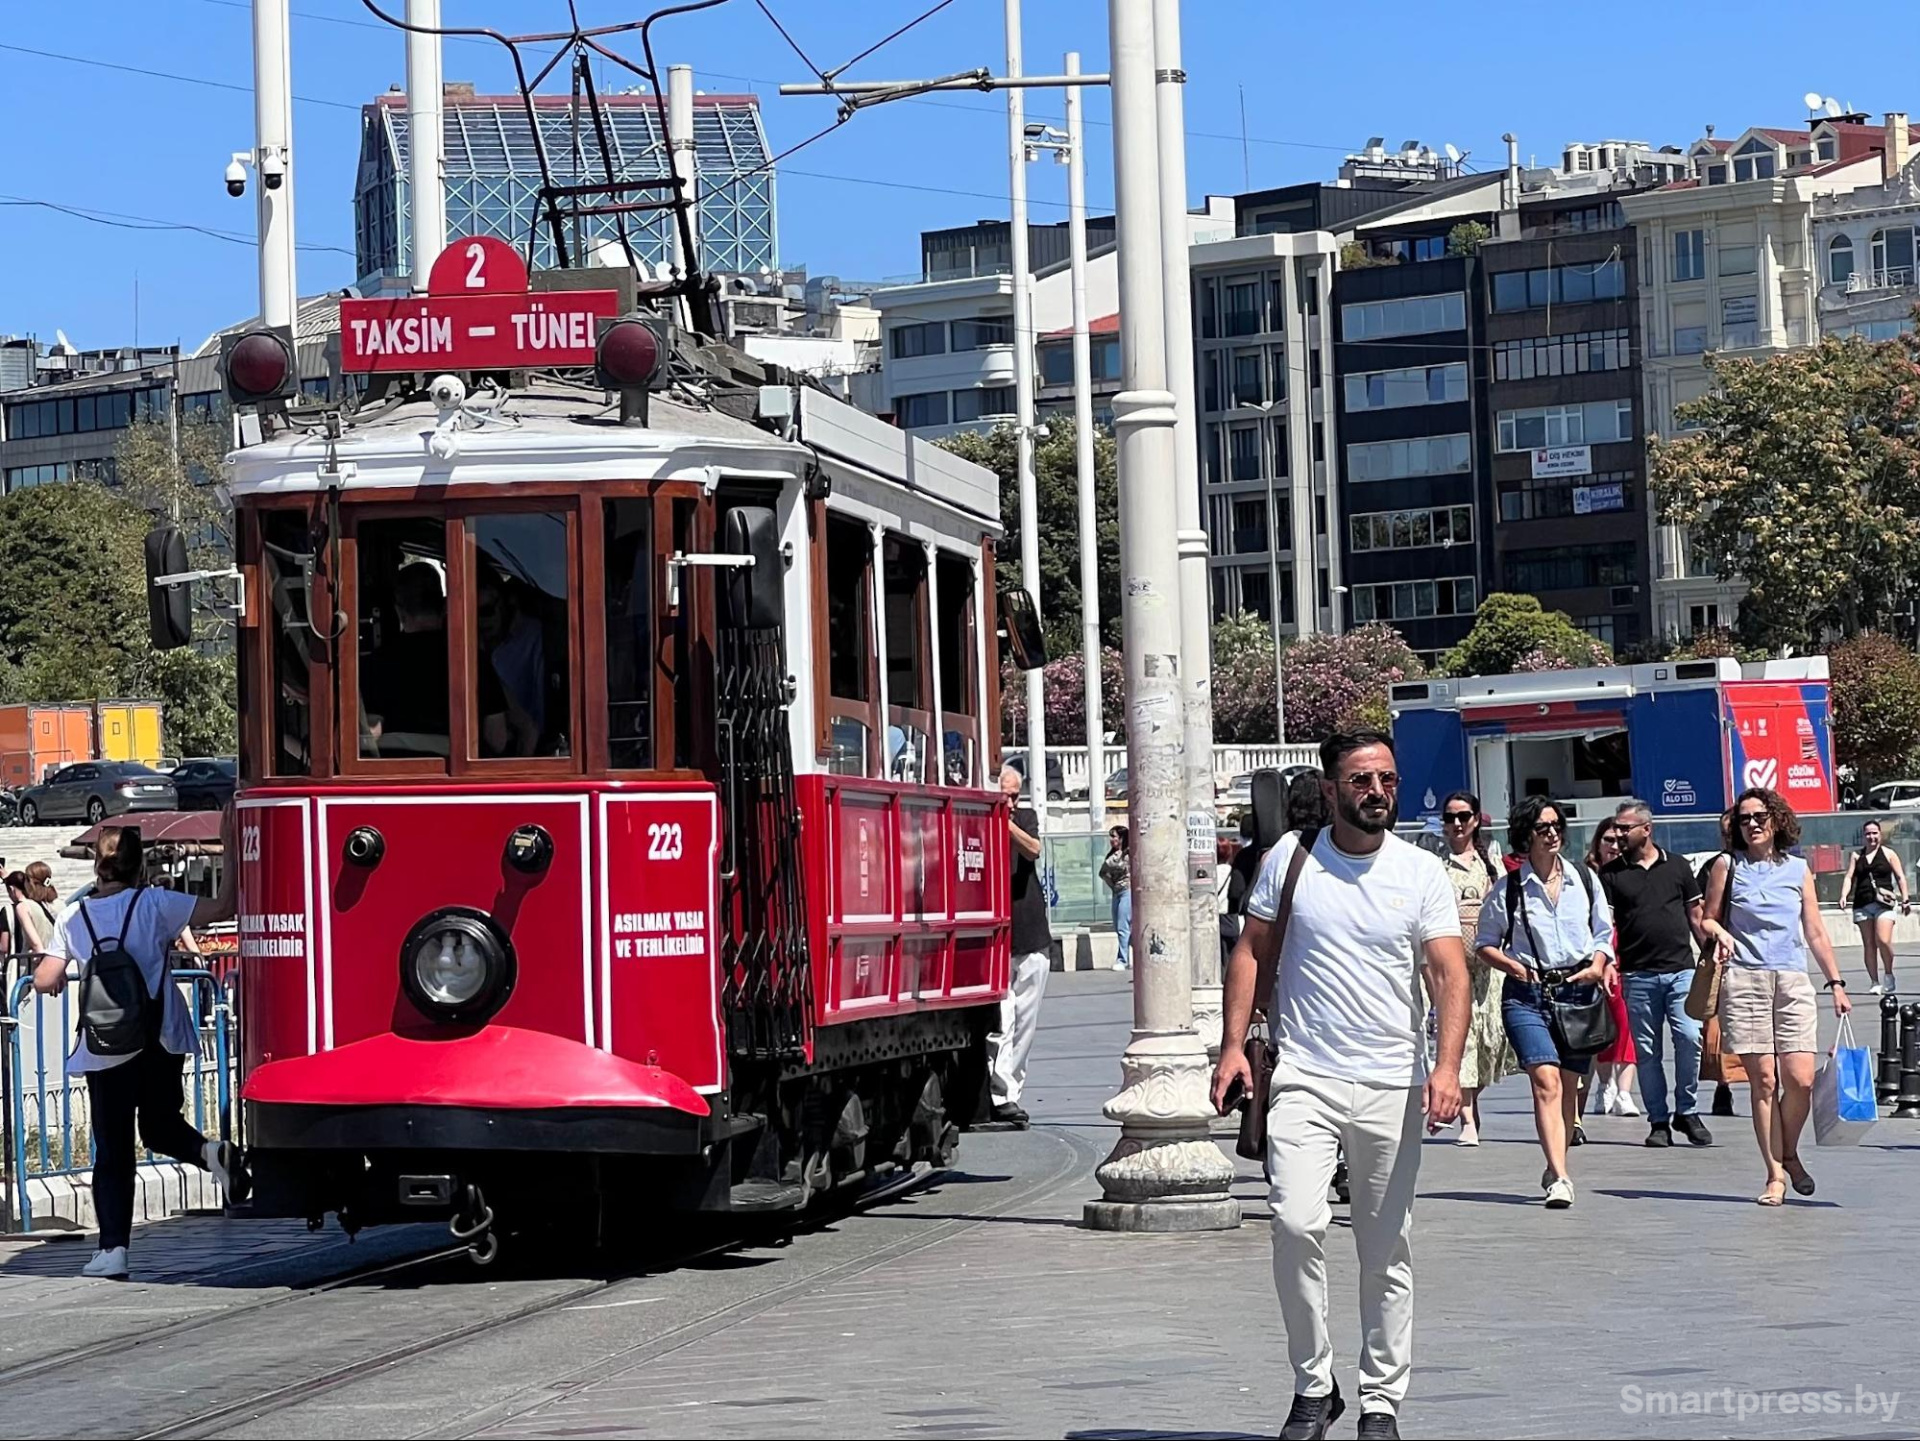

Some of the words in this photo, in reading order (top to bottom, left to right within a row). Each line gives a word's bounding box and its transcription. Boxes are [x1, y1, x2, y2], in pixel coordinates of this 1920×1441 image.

[466, 243, 486, 288] 2
[350, 307, 453, 356] TAKSİM
[1788, 764, 1815, 778] ÇÖZÜM
[1788, 777, 1821, 789] NOKTASI
[1665, 794, 1680, 803] ALO
[647, 822, 683, 860] 223
[267, 913, 304, 932] YASAK
[614, 912, 672, 933] ASILMAK
[615, 939, 631, 958] VE
[634, 933, 705, 957] TEHLİKELİDİR
